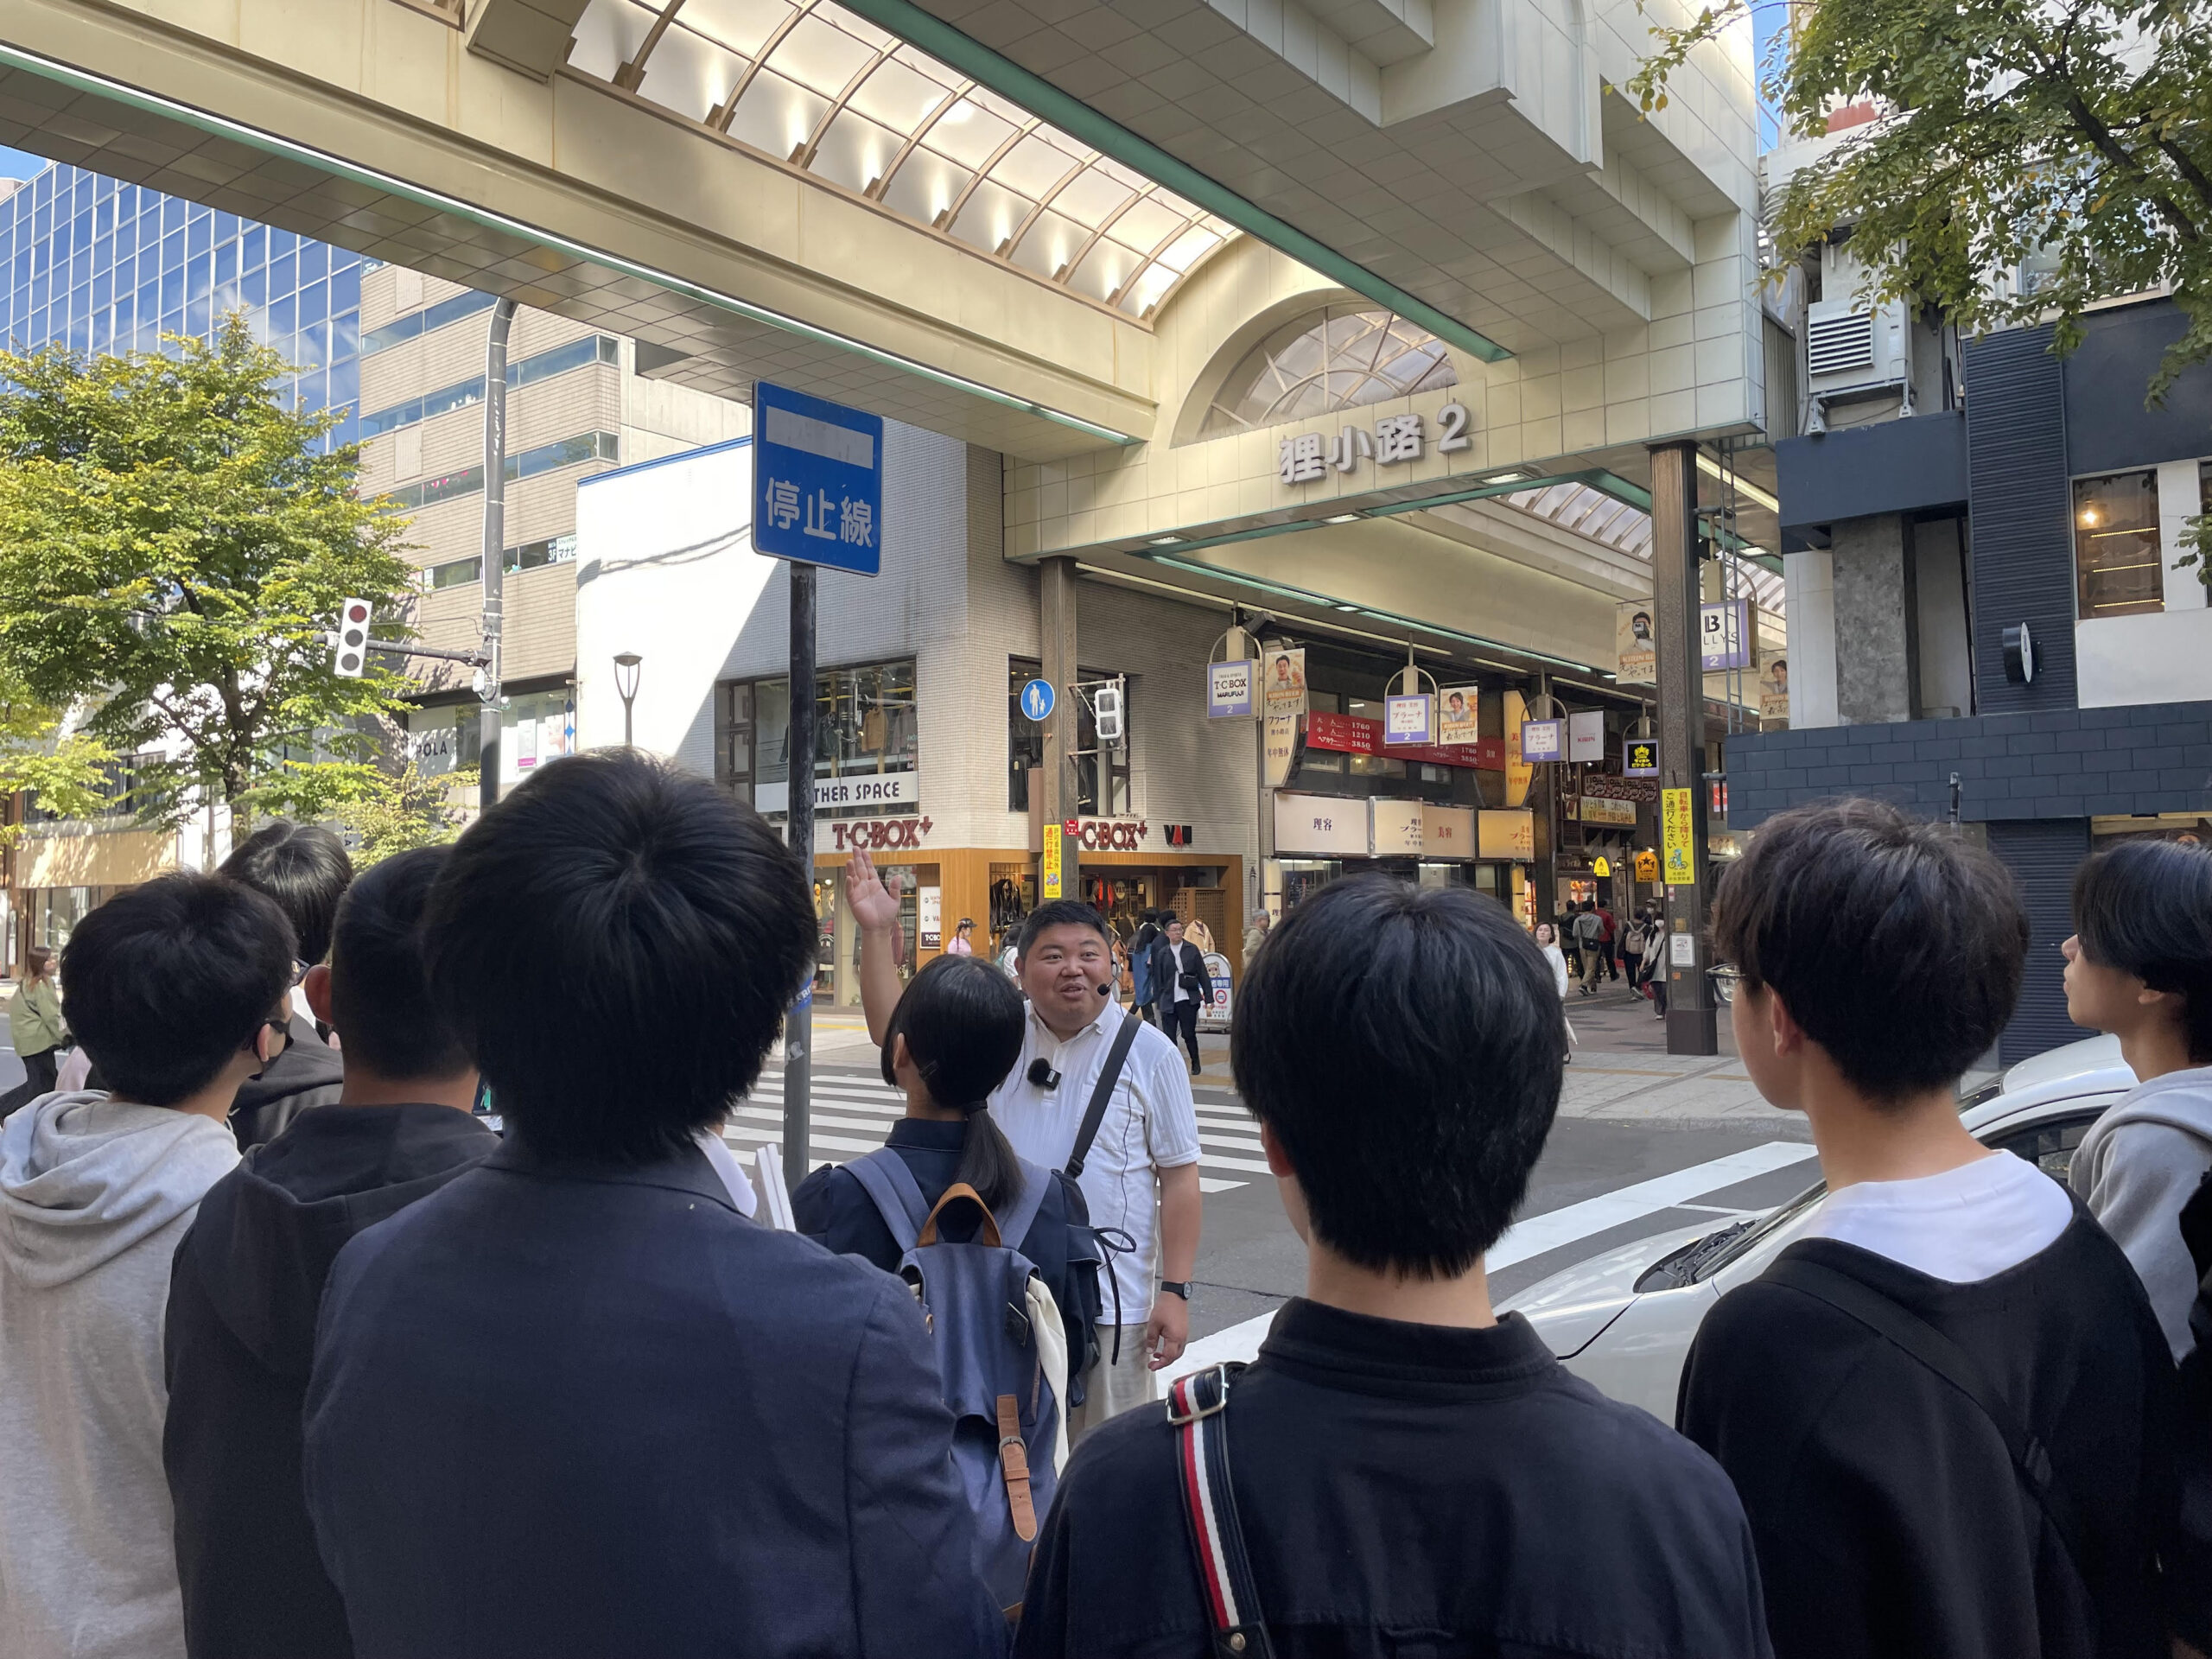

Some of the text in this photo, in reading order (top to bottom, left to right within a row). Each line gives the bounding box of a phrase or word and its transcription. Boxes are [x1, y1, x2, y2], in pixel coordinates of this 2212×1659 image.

[1280, 403, 1471, 486] 狸小路 2
[766, 477, 873, 548] 停止線
[1709, 656, 1719, 666] 2
[1227, 705, 1233, 714] 2
[1351, 721, 1370, 731] 1760
[1351, 731, 1370, 740] 1210
[416, 741, 448, 758] POLA
[1351, 741, 1371, 749] 3850
[814, 781, 899, 803] THER SPACE
[1313, 817, 1332, 831] 理容
[1666, 792, 1676, 849] ご通行ください
[1679, 791, 1689, 848] 自転車から降りて
[1438, 826, 1452, 838] 美容
